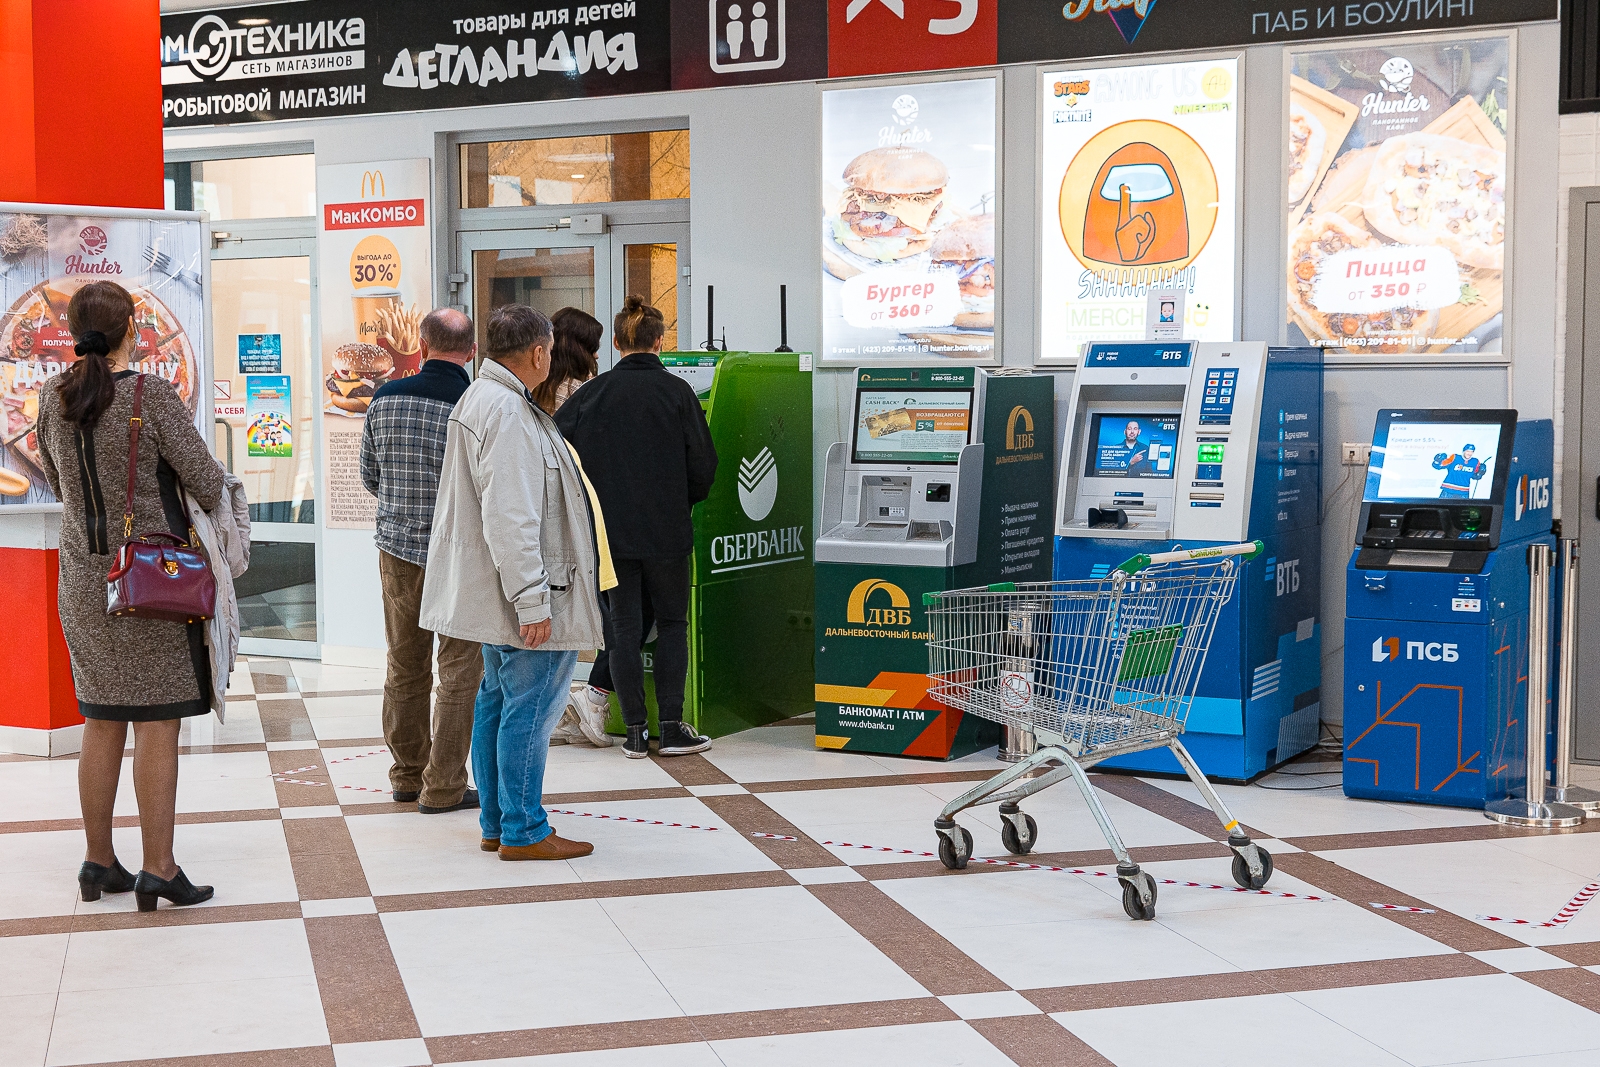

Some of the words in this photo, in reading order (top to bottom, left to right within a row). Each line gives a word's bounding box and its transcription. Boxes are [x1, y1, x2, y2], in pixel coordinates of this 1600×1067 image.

[453, 13, 526, 35] товары
[532, 8, 569, 30] для
[575, 0, 636, 25] детей
[1252, 9, 1308, 34] ПАБ
[1317, 6, 1335, 29] И
[242, 62, 271, 75] СЕТЬ
[276, 55, 353, 72] МАГАЗИНОВ
[383, 29, 638, 90] ДЕТЛАНДИЯ
[1054, 79, 1090, 97] STARS
[162, 88, 271, 118] РОБЫТОВОЙ
[279, 84, 366, 110] МАГАЗИН
[1361, 92, 1431, 118] Hunter
[878, 125, 933, 147] Hunter
[331, 205, 417, 225] МакКОМБО
[65, 255, 123, 275] Hunter
[1345, 258, 1426, 278] Пицца
[867, 281, 934, 303] Бургер
[1371, 282, 1410, 298] 350
[888, 303, 920, 319] 360
[42, 339, 74, 347] ПОЛУЧИ
[1162, 351, 1182, 360] ВТБ
[224, 407, 245, 415] СЕБЯ
[1015, 433, 1035, 451] ДВБ
[1528, 477, 1549, 511] ПСБ
[1005, 504, 1020, 513] Выдача
[1020, 501, 1039, 510] наличных
[1005, 528, 1019, 537] Оплата
[1020, 526, 1031, 536] услуг
[711, 525, 805, 565] СБЕРБАНК
[1005, 540, 1026, 550] Погашение
[1026, 537, 1045, 547] кредитов
[1005, 552, 1024, 562] Открытие
[1276, 559, 1300, 597] ВТБ
[866, 608, 912, 627] ДВБ
[824, 627, 910, 639] ДАЛЬНЕВОСТОЧНЫЙ
[912, 630, 934, 640] БАНК
[1406, 641, 1459, 662] ПСБ
[839, 706, 893, 718] БАНКОМАТ
[839, 720, 895, 730] www.dvbank.ru
